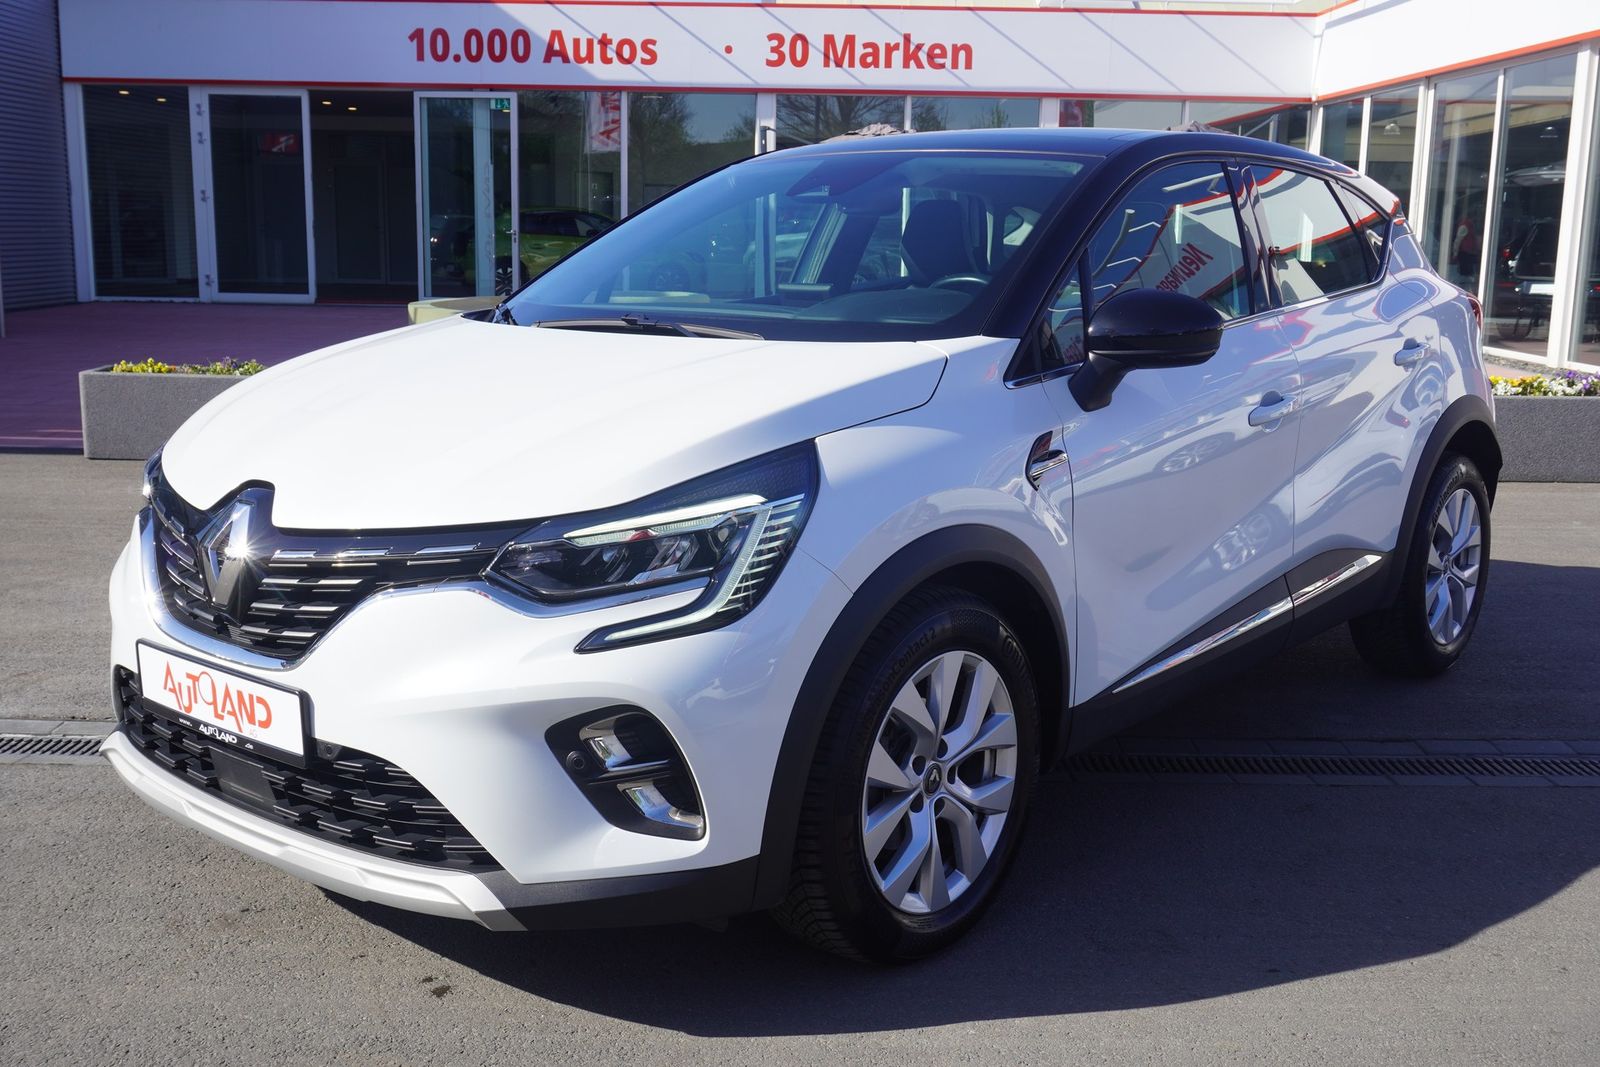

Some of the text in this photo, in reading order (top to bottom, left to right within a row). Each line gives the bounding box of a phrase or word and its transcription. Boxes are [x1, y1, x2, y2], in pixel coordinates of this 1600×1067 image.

[408, 28, 973, 70] 10.000 Autos 30 Marken
[163, 661, 272, 732] AUTOLAND
